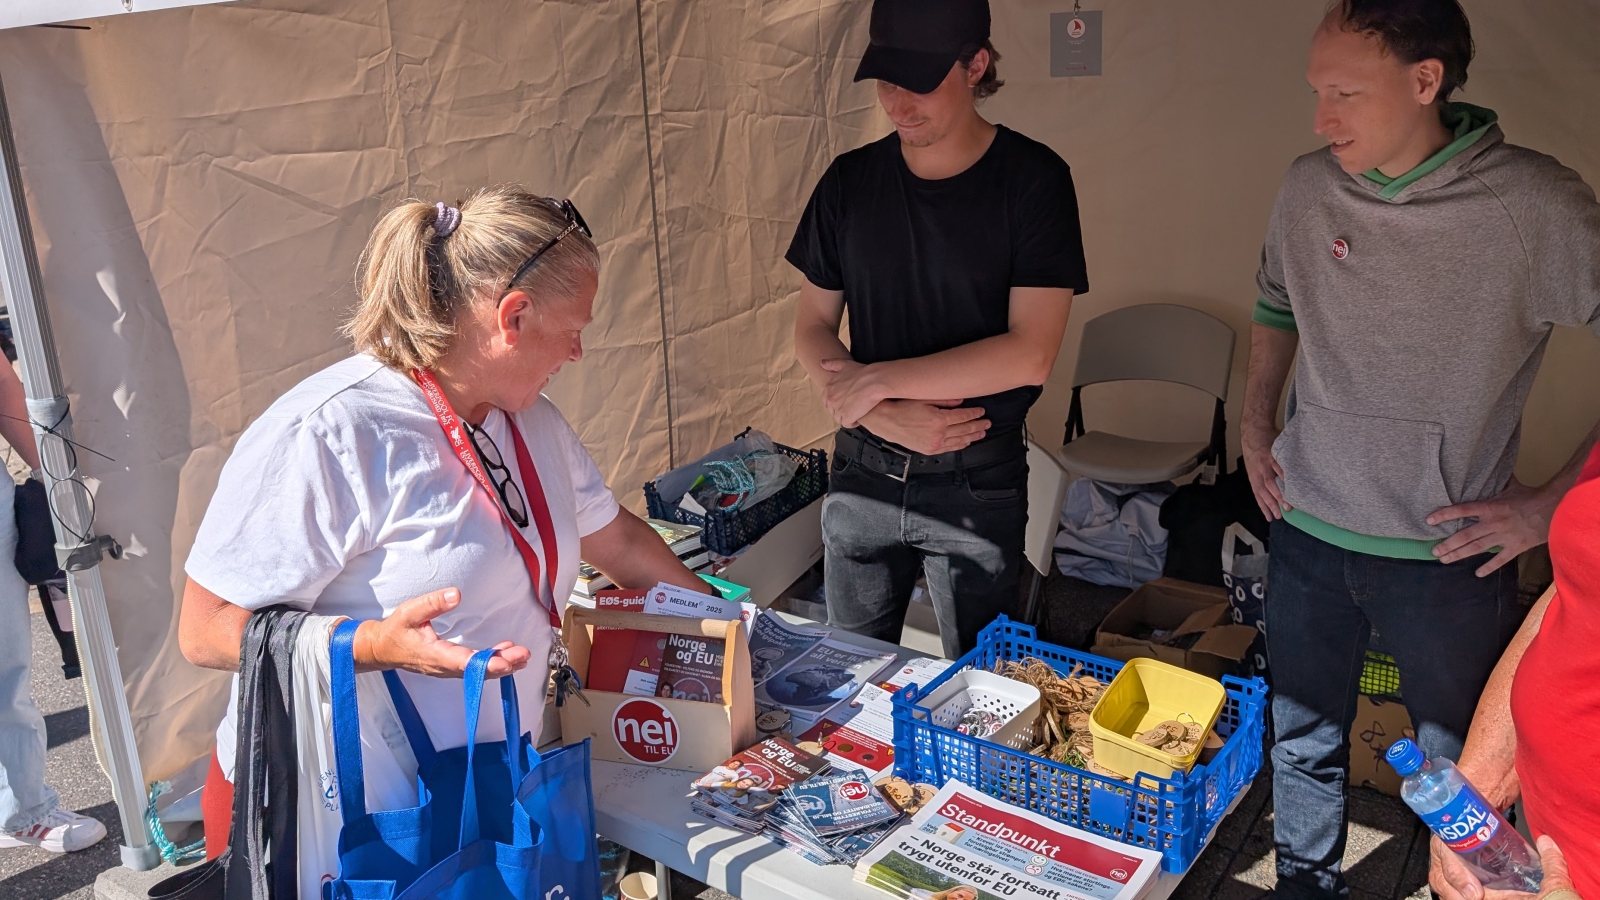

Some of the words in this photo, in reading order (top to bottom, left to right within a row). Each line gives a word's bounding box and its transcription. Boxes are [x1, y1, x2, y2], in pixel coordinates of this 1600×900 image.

[428, 380, 449, 414] LIVERPOOL
[446, 414, 454, 423] FC
[464, 449, 486, 485] LIVERPOOL
[599, 596, 646, 608] EØS-guid
[670, 597, 699, 608] MEDLEM
[706, 606, 722, 614] 2025
[669, 634, 706, 652] Norge
[817, 646, 834, 654] EU
[676, 650, 692, 664] og
[696, 651, 714, 664] EU
[617, 710, 674, 746] nei
[644, 745, 659, 754] TIL
[662, 746, 674, 755] EU
[761, 738, 794, 758] Norge
[762, 748, 778, 759] og
[776, 756, 796, 768] EU
[841, 783, 868, 799] nei
[942, 804, 1060, 858] Standpunkt
[1437, 808, 1486, 841] MSDAL
[1479, 830, 1487, 838] T
[898, 841, 935, 862] trygt
[935, 860, 992, 886] utenfor
[992, 882, 1017, 896] EU
[920, 840, 966, 863] Norge
[967, 860, 1000, 876] står
[1000, 871, 1060, 900] fortsatt
[1047, 871, 1072, 882] partiene
[1050, 866, 1063, 874] Hva
[1063, 870, 1082, 879] mener
